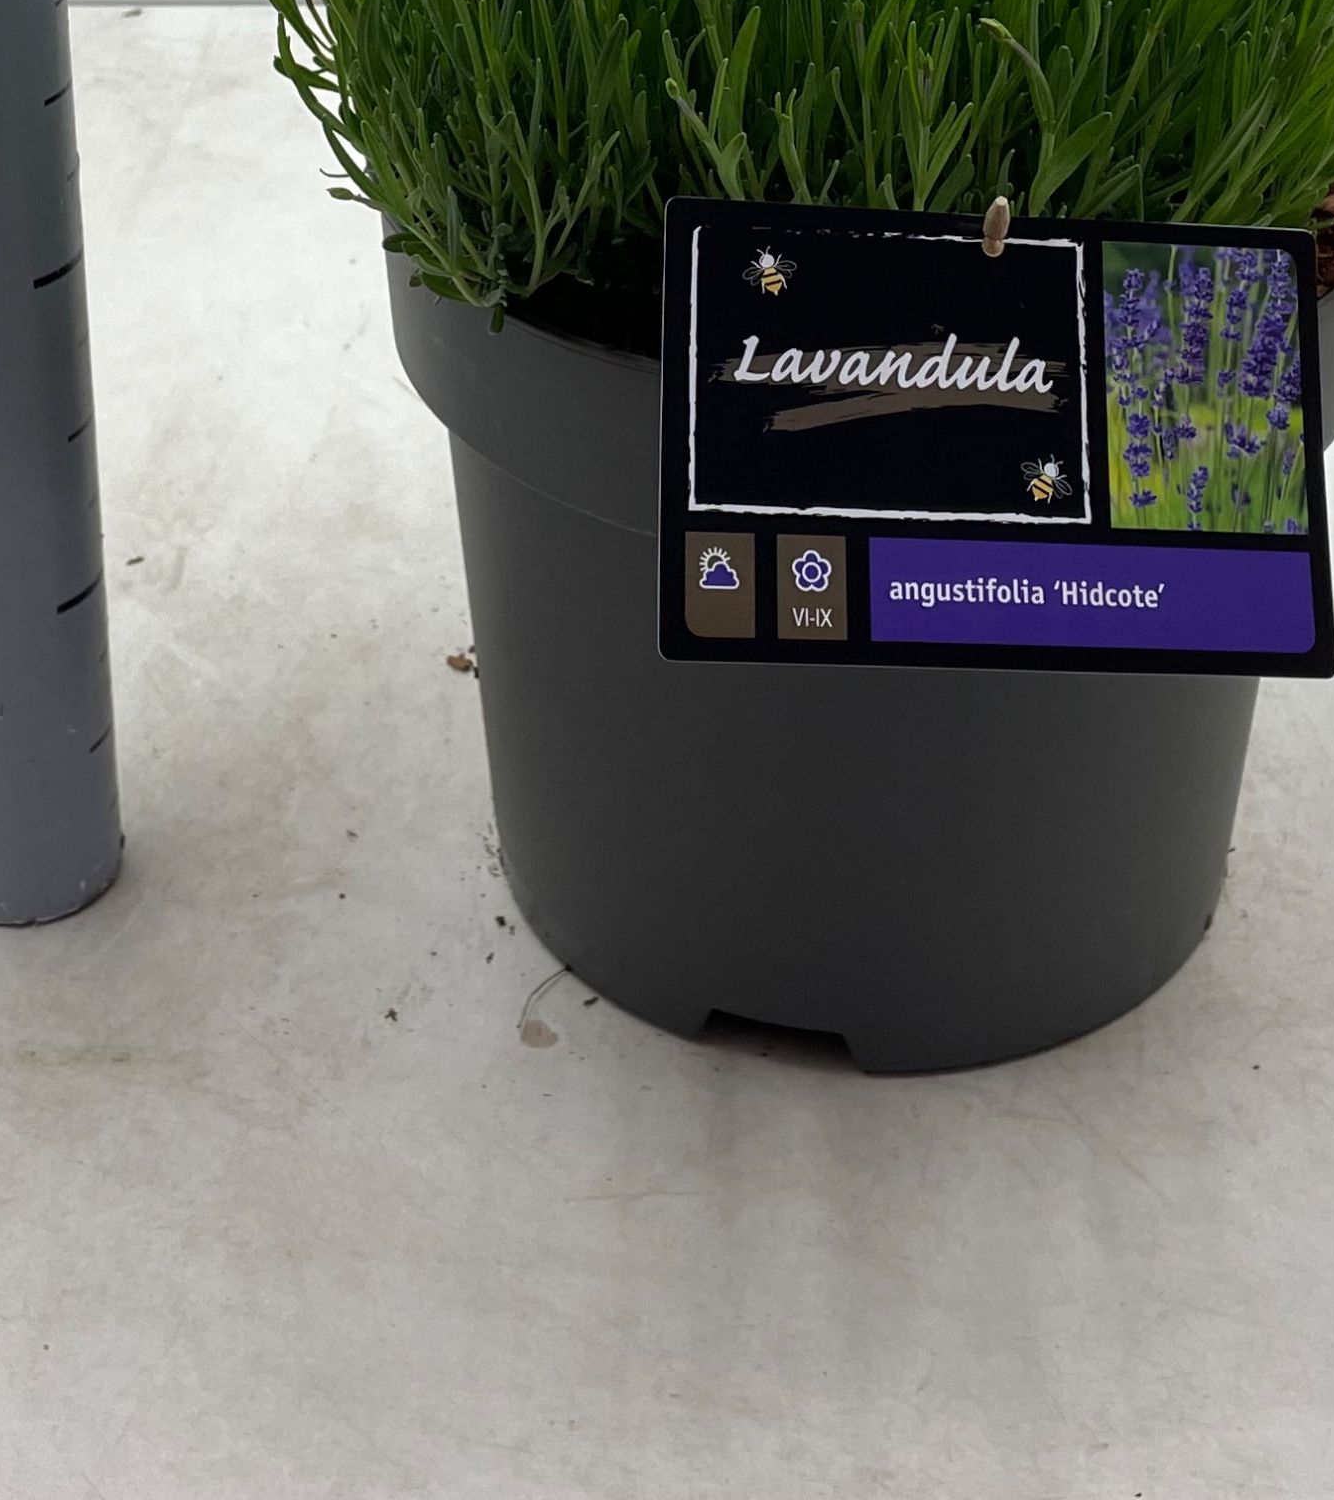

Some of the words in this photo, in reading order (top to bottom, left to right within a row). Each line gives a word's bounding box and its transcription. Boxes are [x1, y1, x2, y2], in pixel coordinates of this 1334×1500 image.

[733, 333, 1054, 395] Lavandula
[889, 577, 1046, 608] angustifolia
[792, 607, 834, 629] VI-IX
